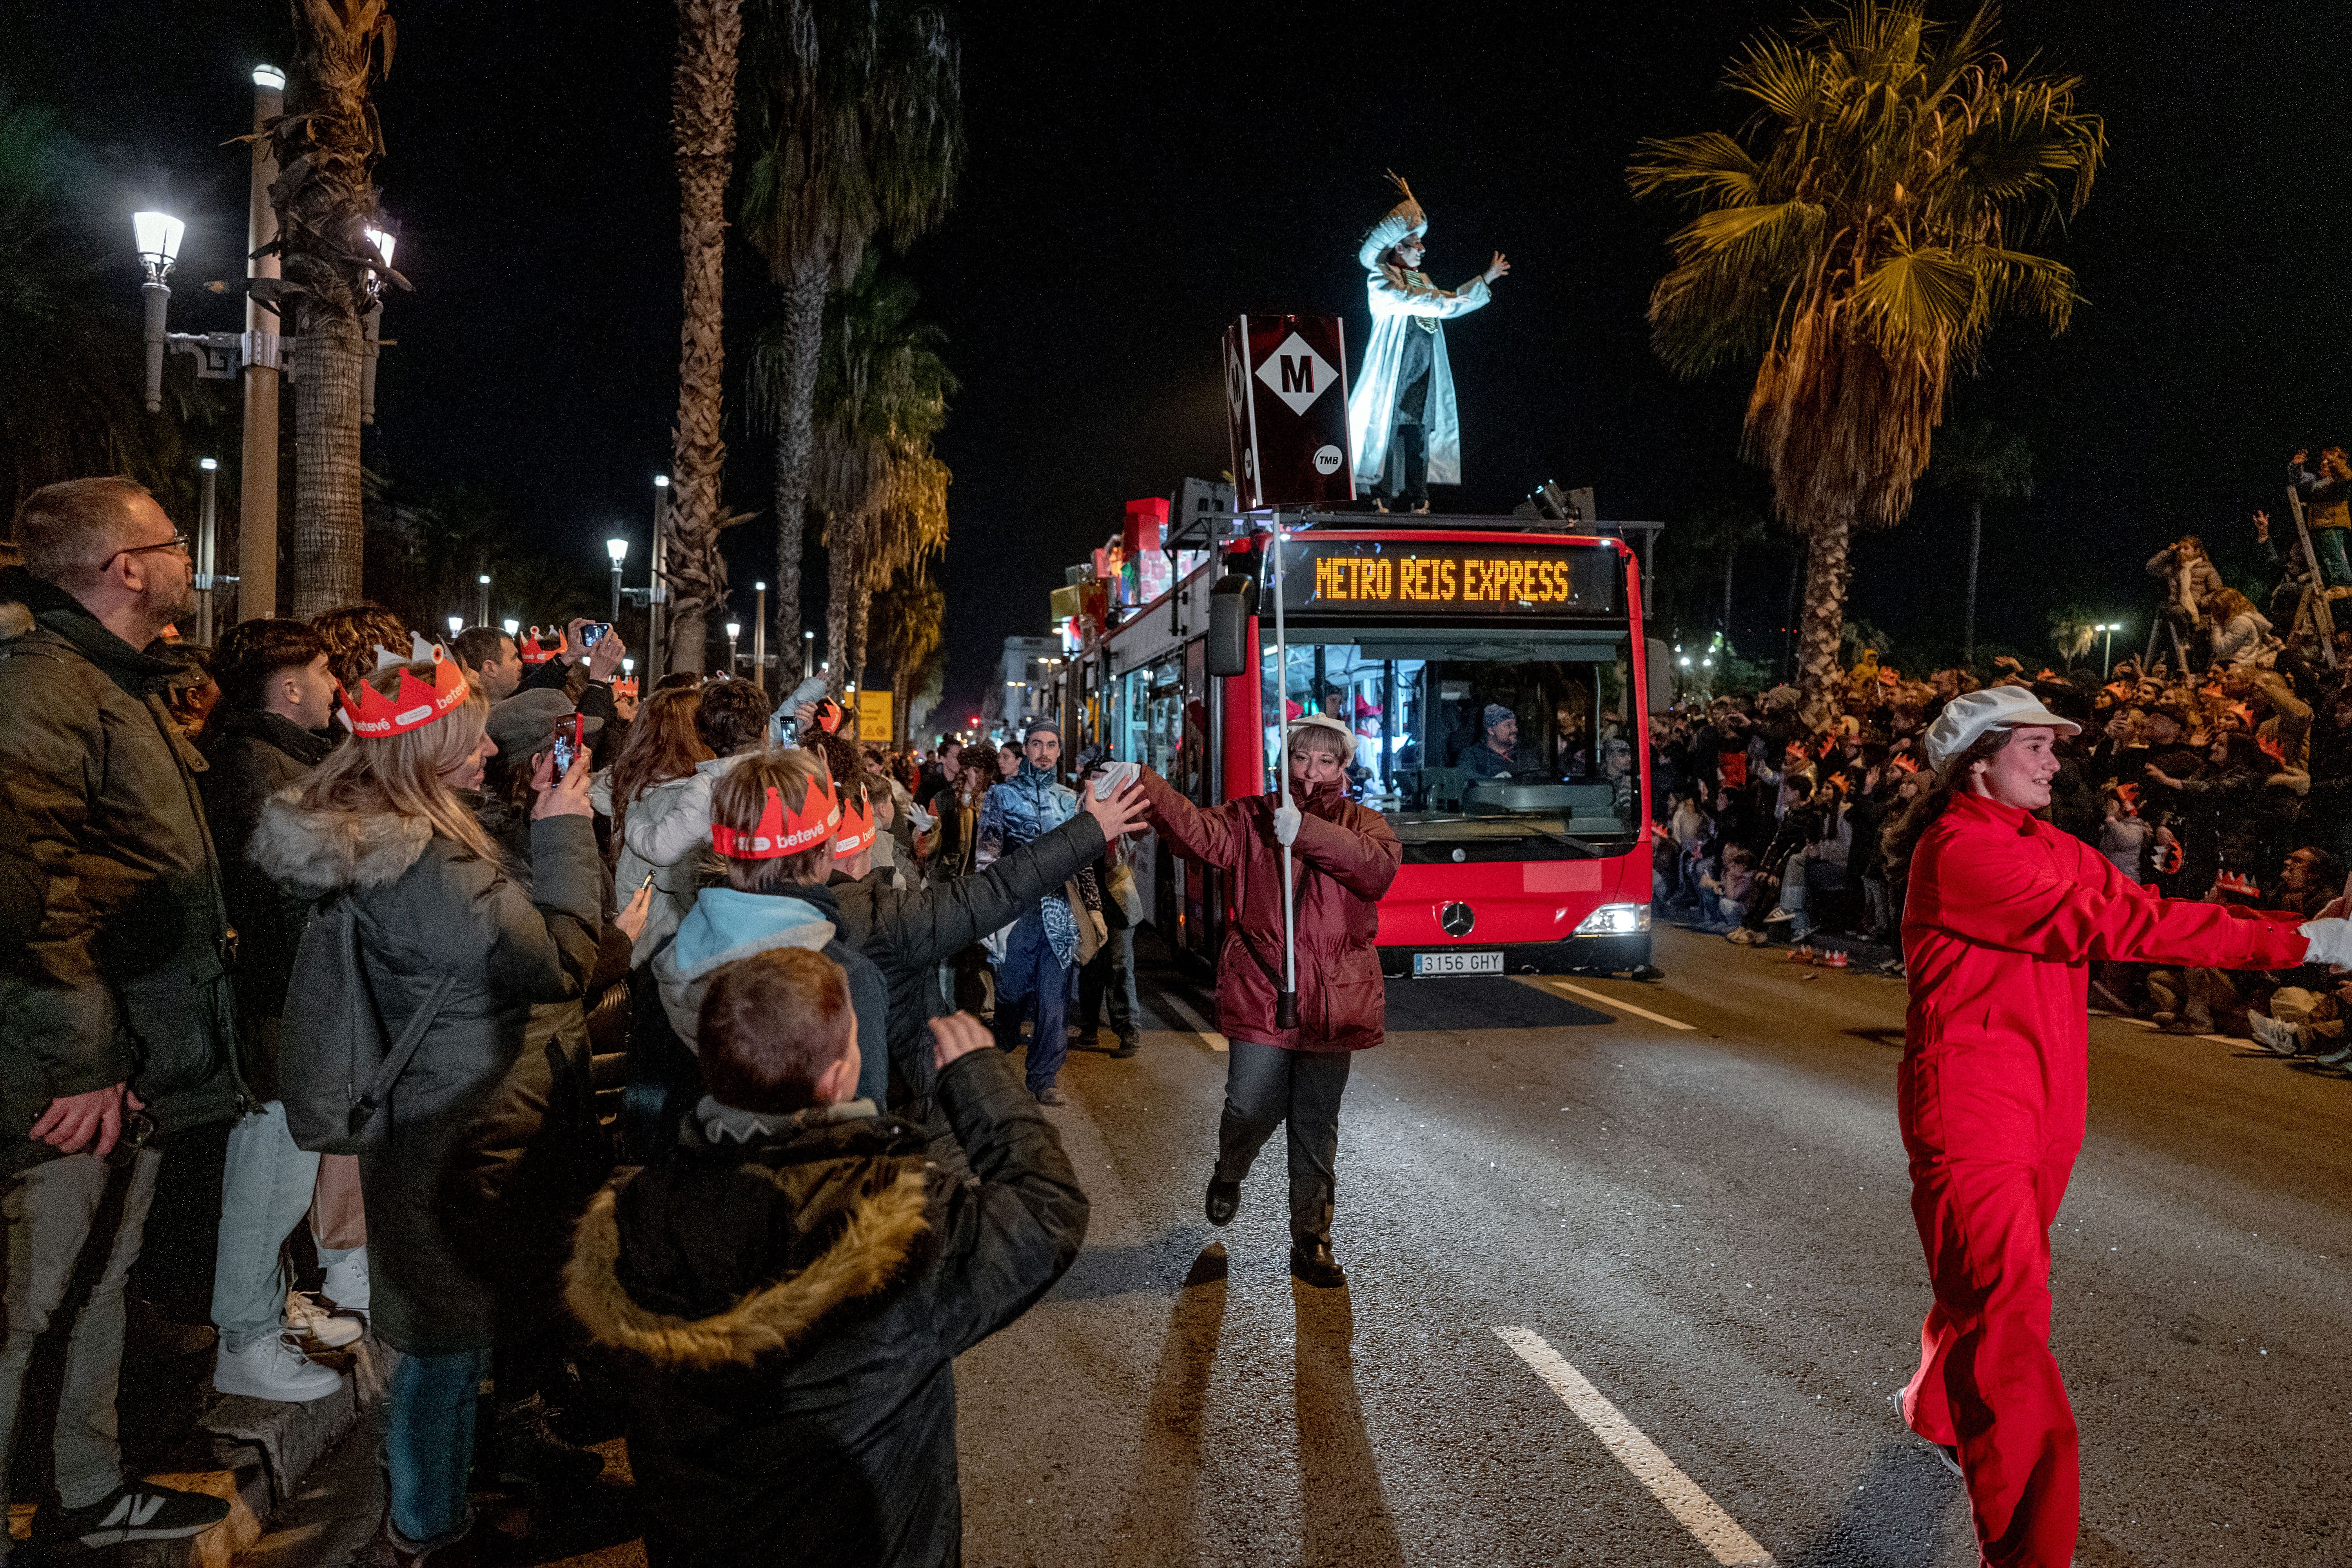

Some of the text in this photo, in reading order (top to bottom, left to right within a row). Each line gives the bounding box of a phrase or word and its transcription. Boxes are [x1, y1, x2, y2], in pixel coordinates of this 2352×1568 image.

[1231, 363, 1241, 404] M
[1280, 355, 1314, 392] M
[1319, 456, 1338, 465] TMB
[1316, 558, 1569, 601] METRO REIS EXPRESS
[776, 820, 825, 849] betevé
[1425, 955, 1499, 971] 3156 GHY
